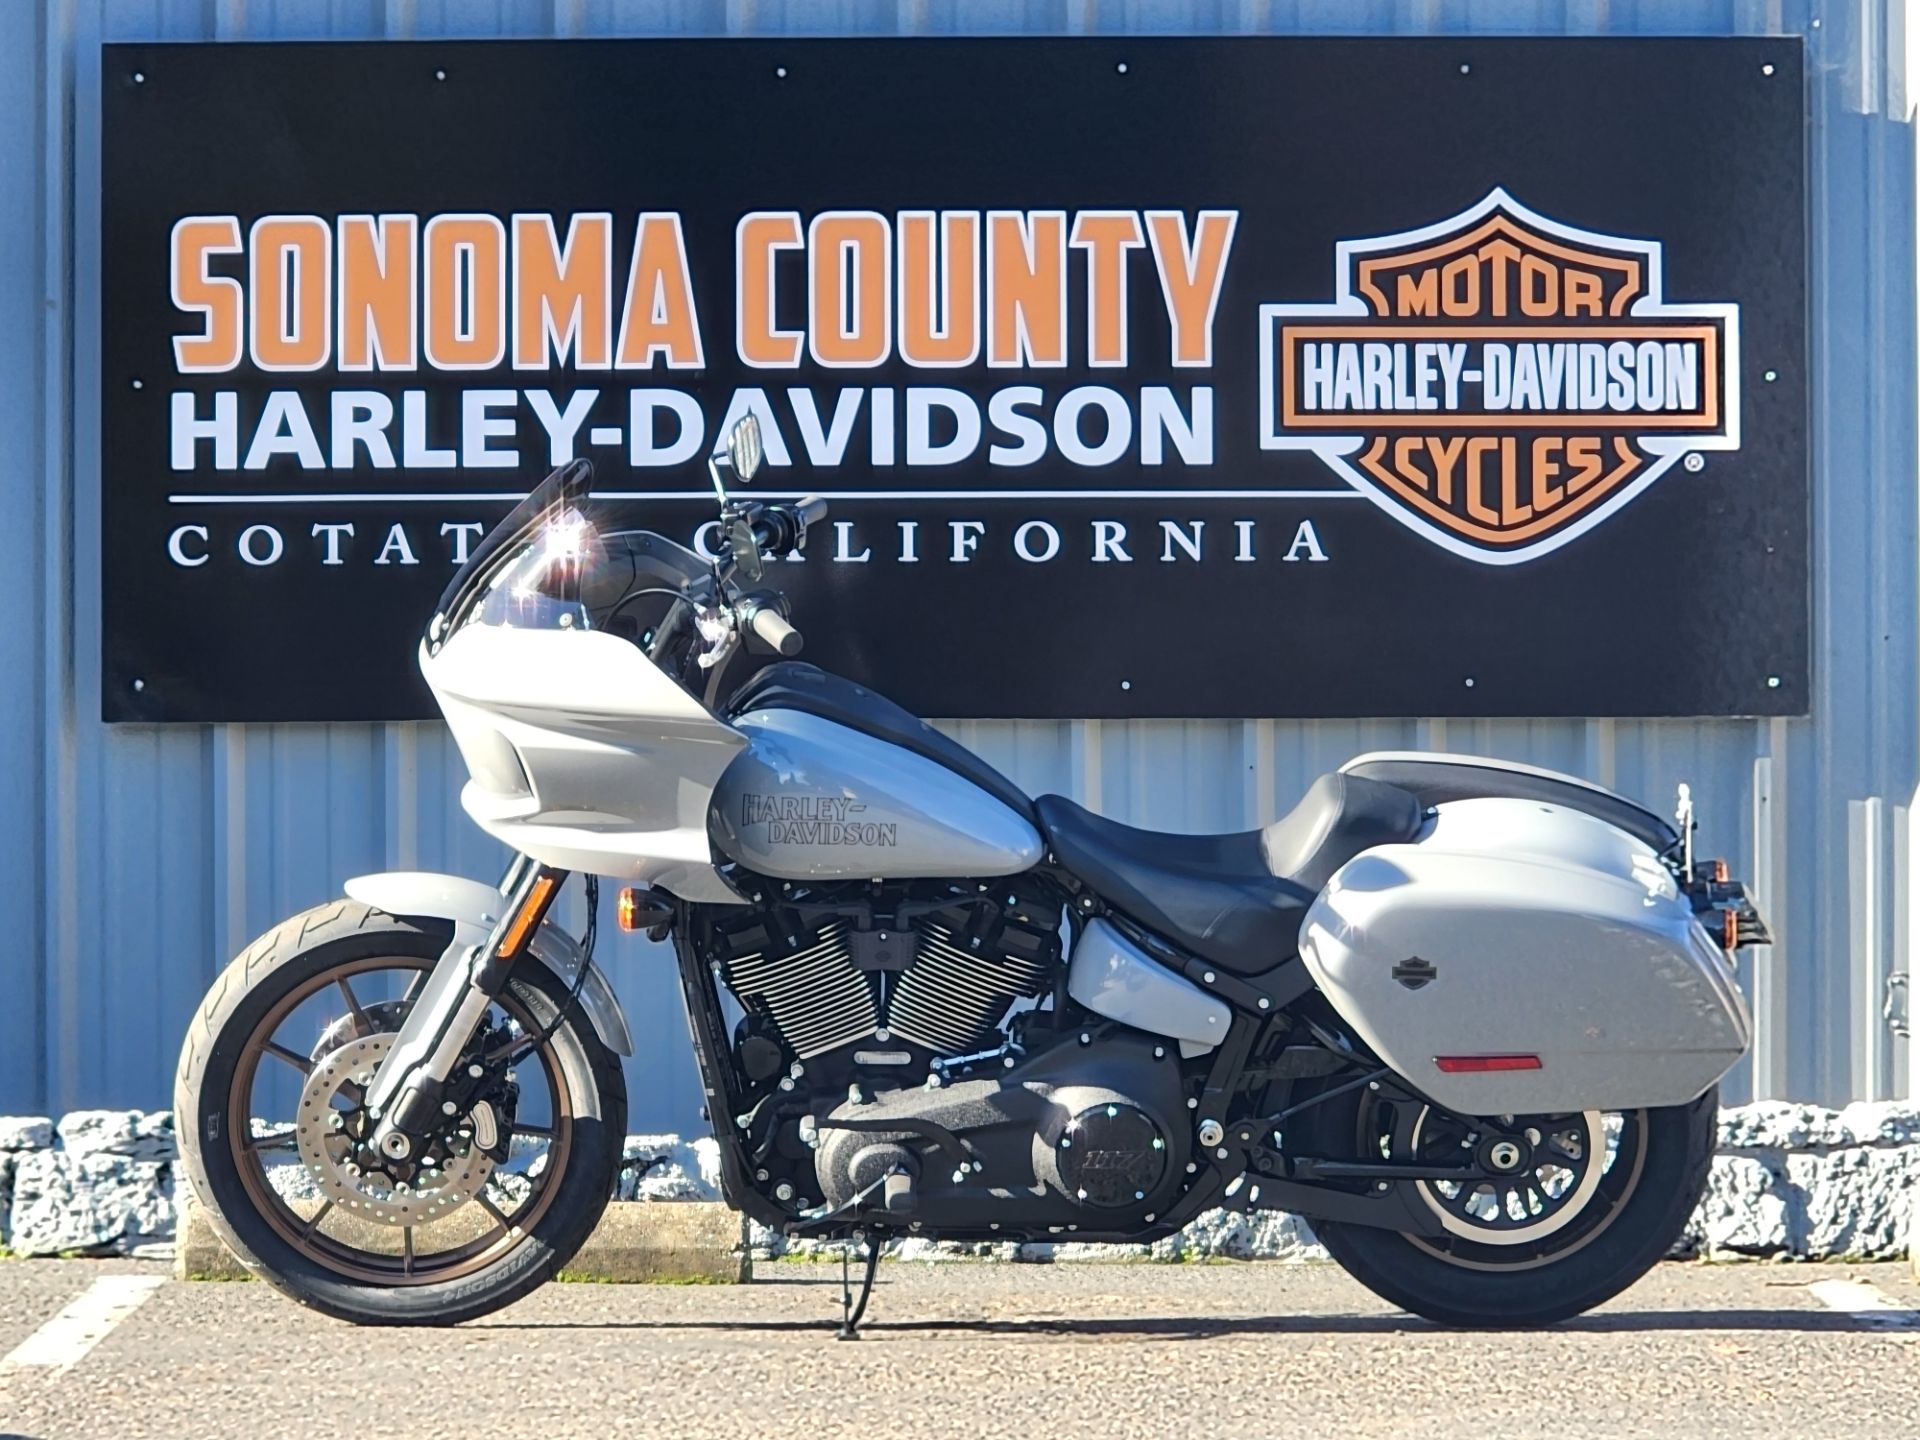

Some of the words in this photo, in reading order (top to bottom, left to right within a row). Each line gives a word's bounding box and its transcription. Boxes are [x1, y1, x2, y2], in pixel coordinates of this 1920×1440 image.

[170, 212, 706, 374] SONOMA
[735, 210, 1239, 369] COUNTY
[1397, 239, 1603, 317] MOTOR
[1303, 341, 1697, 411] HARLEY-DAVIDSON
[171, 386, 1214, 470] HARLEY-DAVIDSON
[1394, 437, 1602, 526] CYCLES
[168, 522, 484, 567] COTAT
[693, 519, 1329, 563] CLIFORNIA
[742, 793, 867, 827] HARLEY-
[768, 822, 897, 847] DAVIDSON
